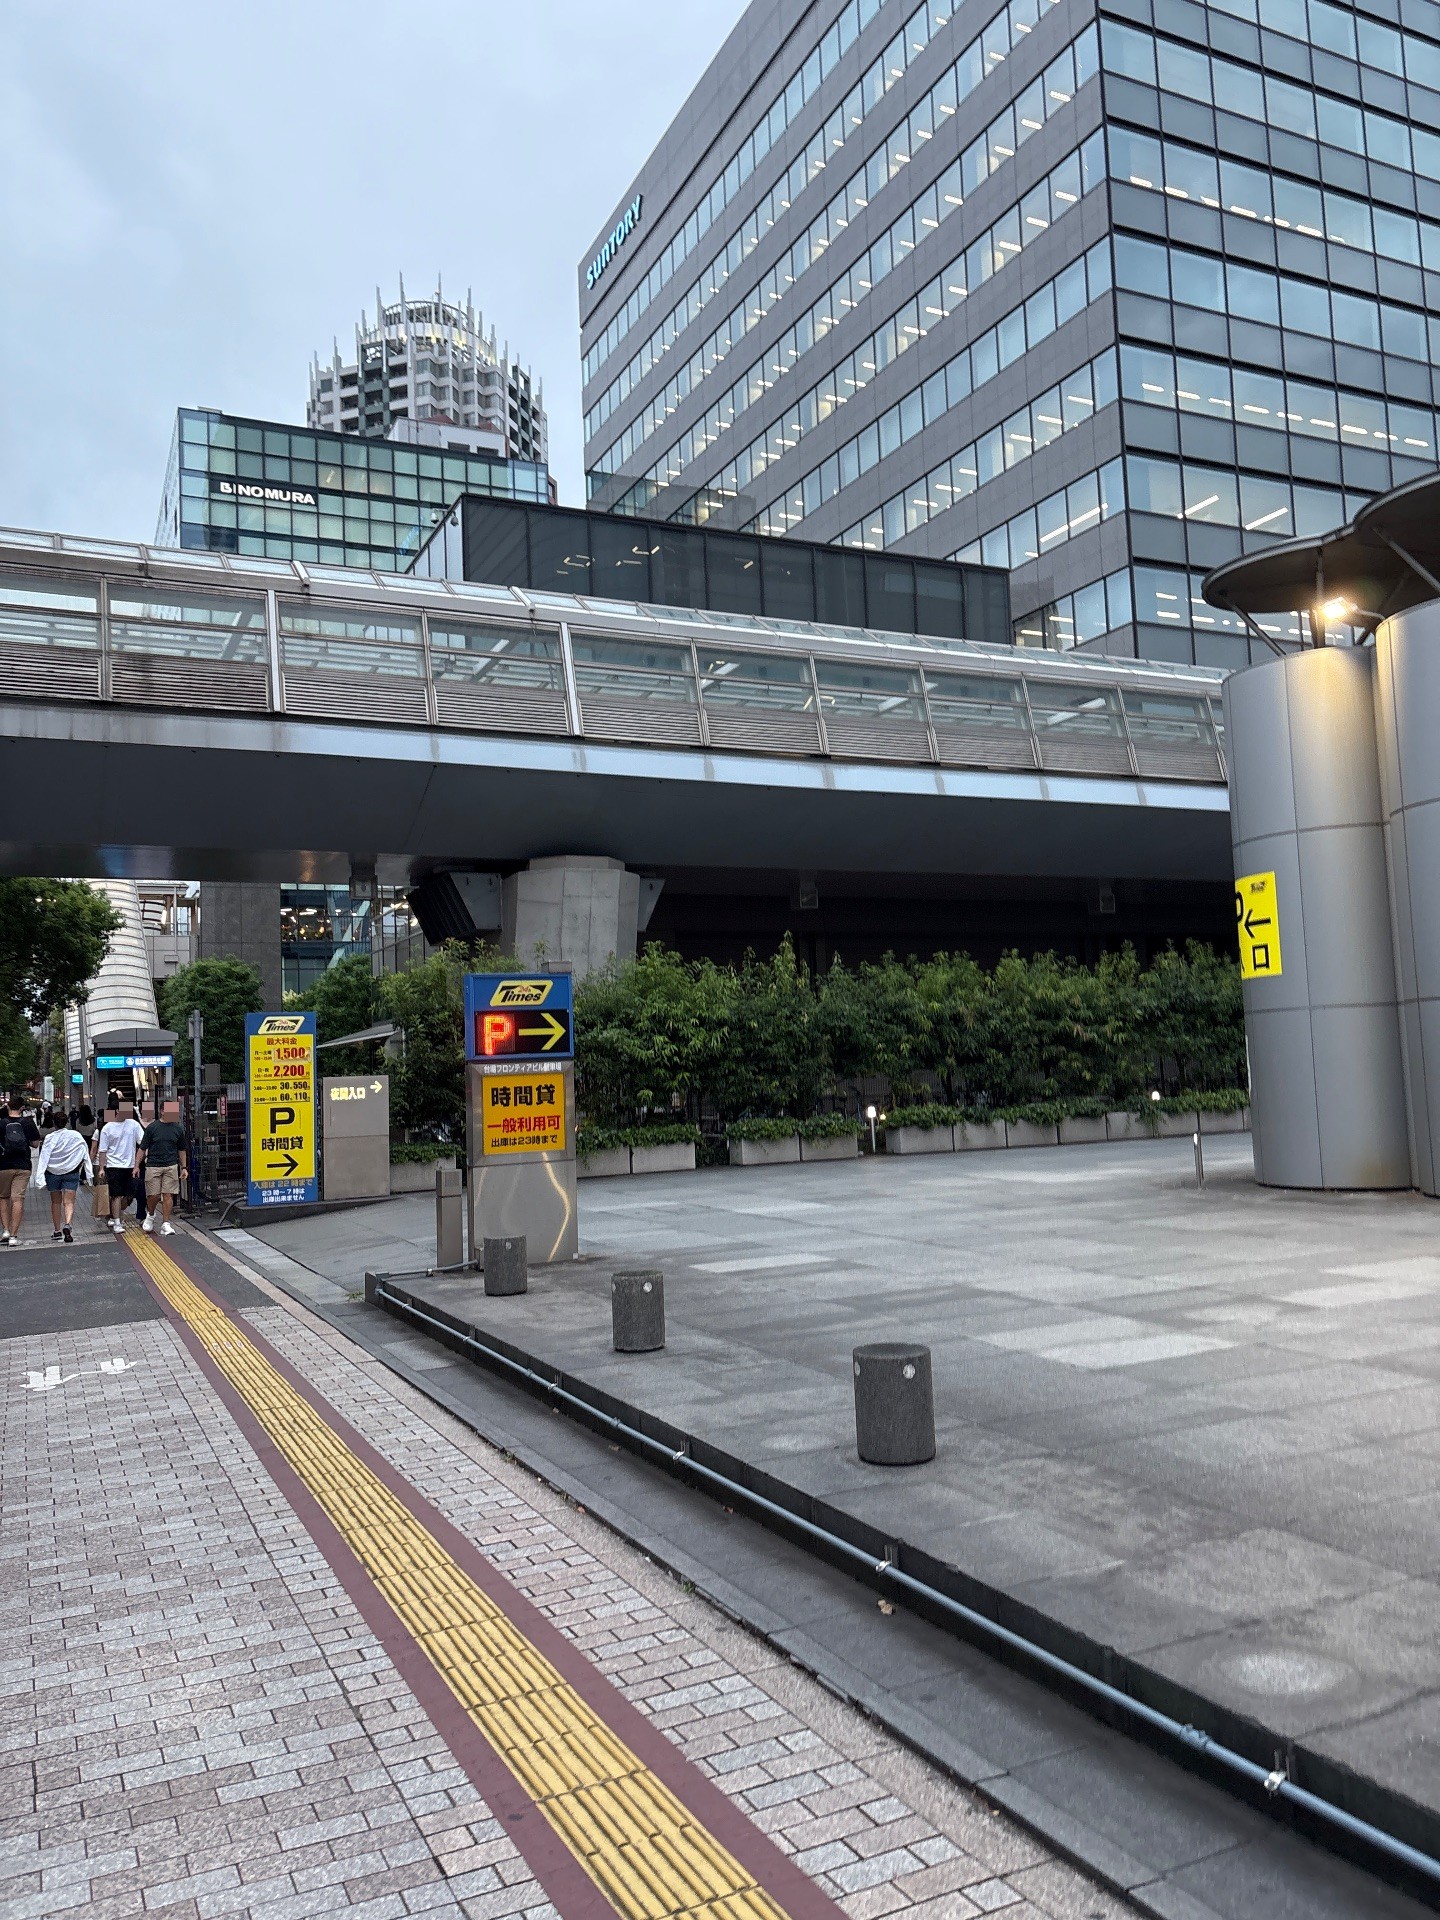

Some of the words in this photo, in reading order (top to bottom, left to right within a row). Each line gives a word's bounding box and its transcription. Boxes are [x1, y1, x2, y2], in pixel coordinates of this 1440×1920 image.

[499, 985, 547, 1003] Times
[265, 1019, 300, 1032] Times
[484, 1016, 511, 1055] P
[491, 1084, 555, 1107] 時間貸
[270, 1107, 295, 1134] P
[487, 1115, 560, 1133] 一般利用可
[262, 1136, 303, 1151] 時間貸
[491, 1134, 557, 1147] 出庫は23時まで
